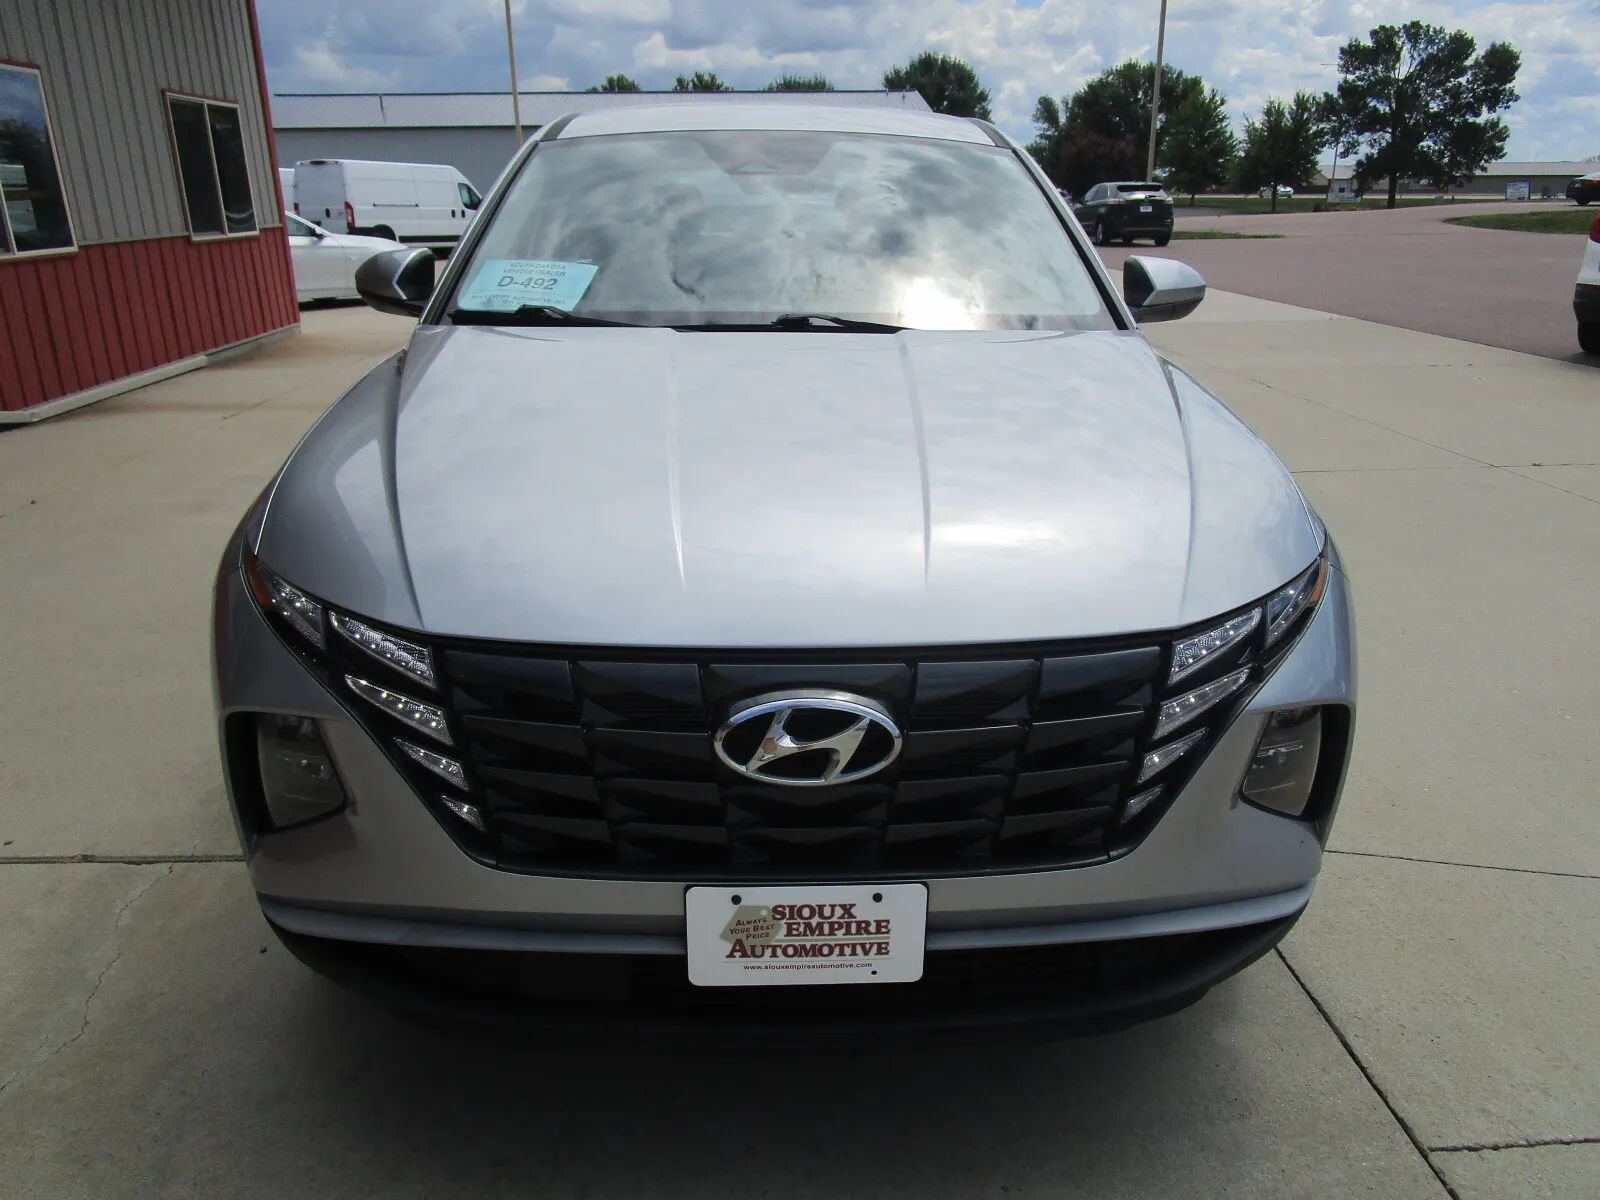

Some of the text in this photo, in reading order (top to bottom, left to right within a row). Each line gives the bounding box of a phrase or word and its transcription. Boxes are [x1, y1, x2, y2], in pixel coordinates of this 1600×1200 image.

[497, 275, 558, 291] D-492
[771, 903, 857, 921] SIOUX
[735, 917, 768, 926] ALWAYS
[784, 919, 891, 937] EMPIRE
[729, 924, 776, 935] YOUR BEST
[746, 932, 770, 940] PRICE
[726, 939, 890, 958] AUTOMOTIVE
[743, 962, 873, 971] www.siouxempireautomotive.com
